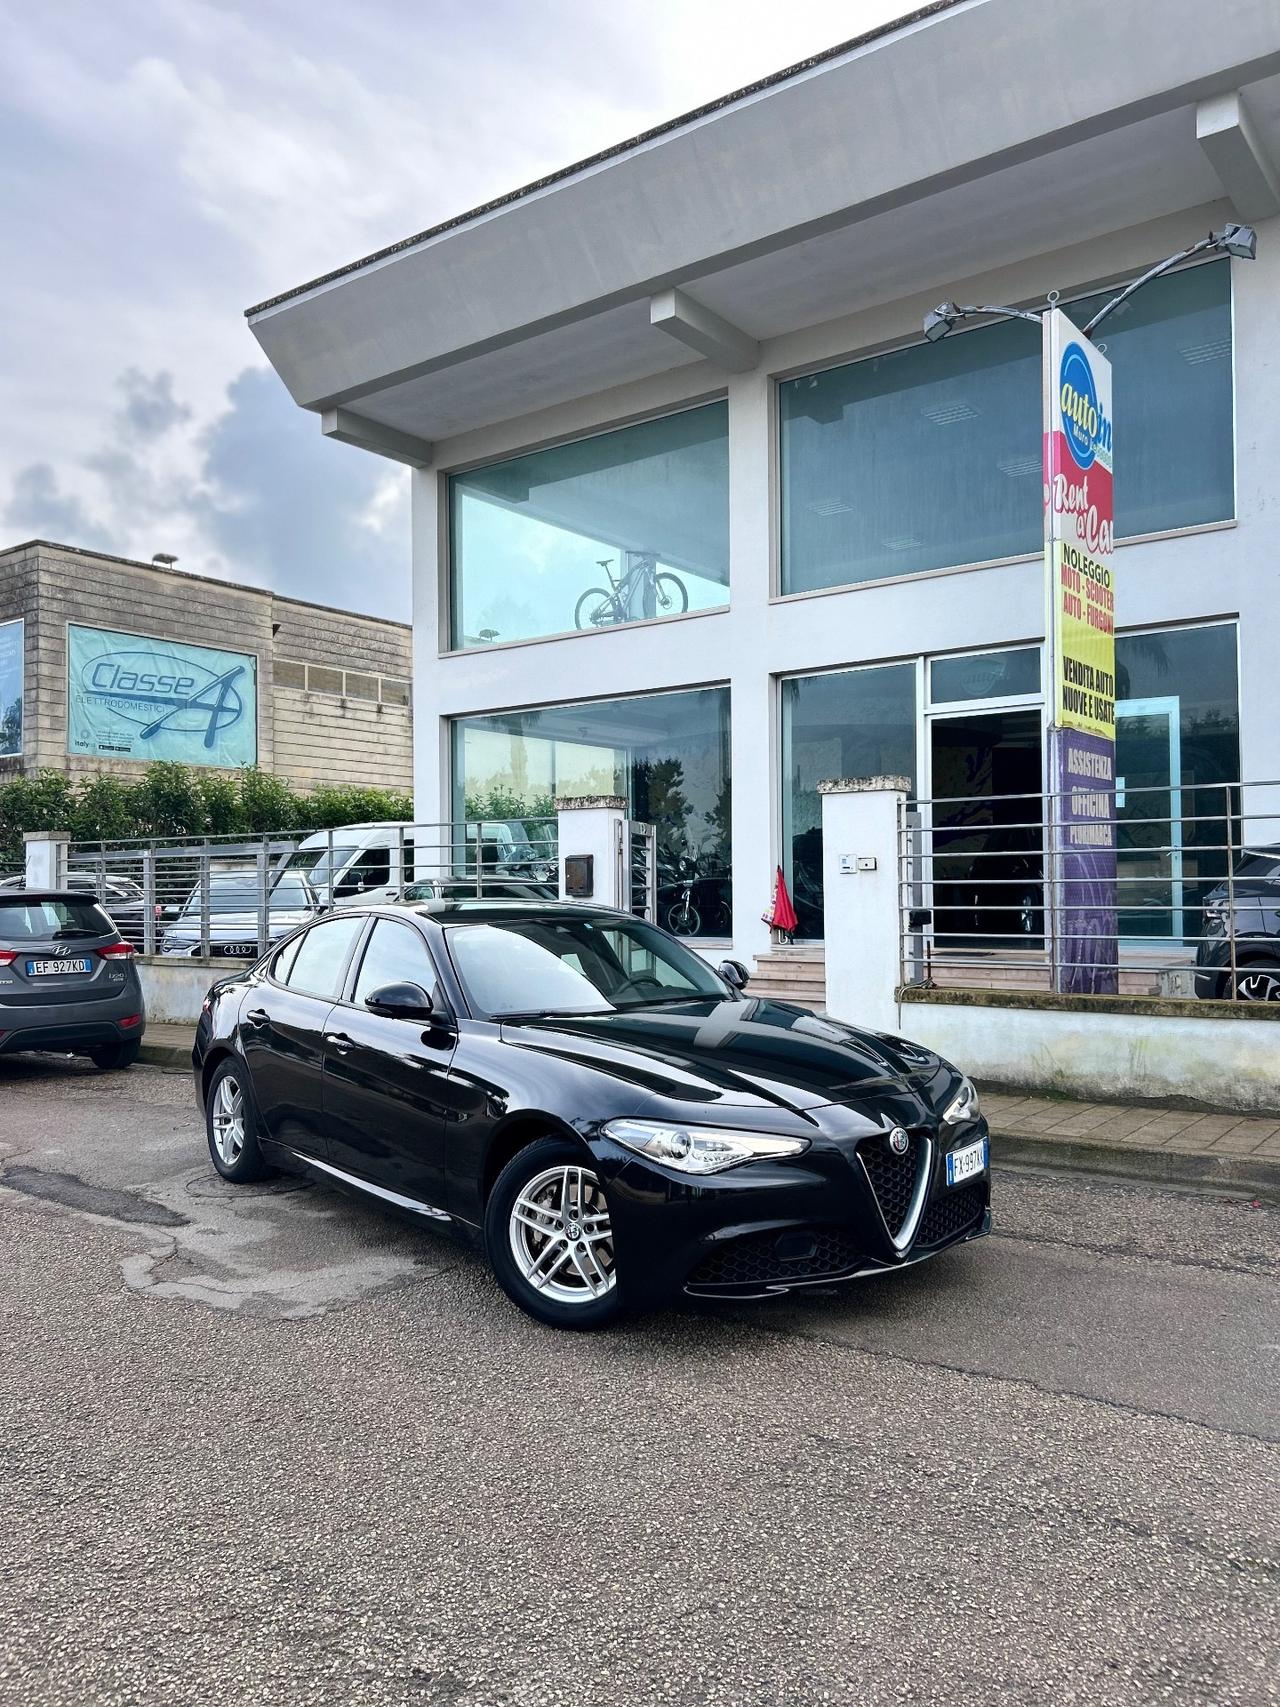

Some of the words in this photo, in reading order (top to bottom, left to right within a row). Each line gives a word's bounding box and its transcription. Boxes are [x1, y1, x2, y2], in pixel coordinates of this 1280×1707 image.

[1054, 473, 1089, 513] Rent
[1063, 543, 1110, 588] NOLEGGIO
[1061, 562, 1080, 594] MOTO
[1085, 577, 1114, 612] SCOOTER
[1063, 591, 1081, 620] AUTO
[91, 662, 194, 695] Classe
[1063, 655, 1095, 691] VENDITA
[1095, 669, 1114, 698] AUTO
[76, 694, 165, 713] ELETTRODOMESTICI
[1062, 685, 1087, 717] NUOVE
[1088, 694, 1093, 718] E
[1094, 696, 1115, 726] USATE
[1068, 748, 1112, 781] ASSISTENZA
[1071, 786, 1111, 819] OFFICINA
[36, 962, 49, 973] EF
[53, 961, 85, 973] 927KD
